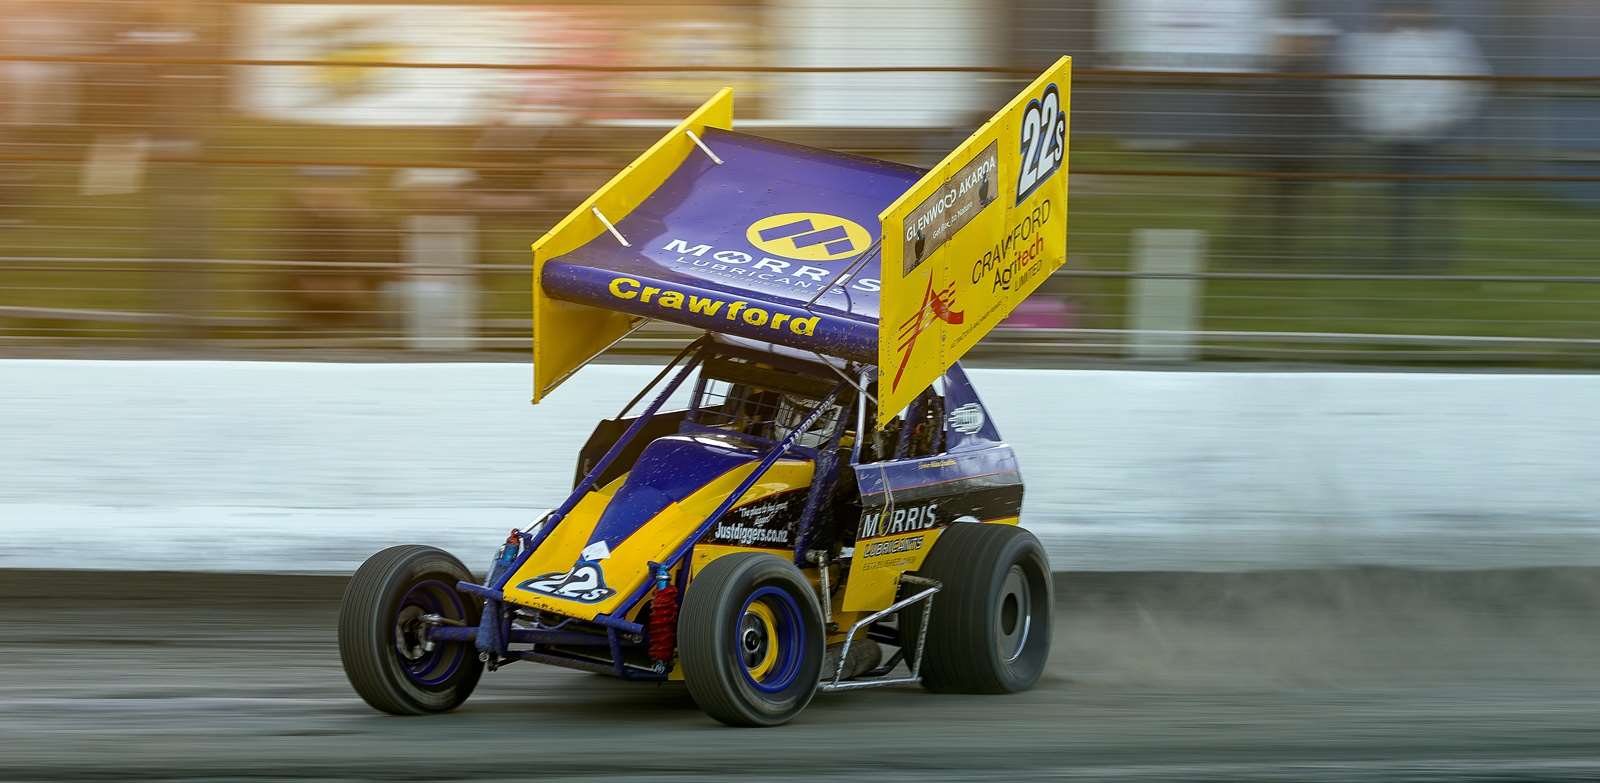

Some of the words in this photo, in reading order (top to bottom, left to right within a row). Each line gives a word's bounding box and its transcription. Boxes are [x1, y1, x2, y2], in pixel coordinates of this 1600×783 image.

[1018, 90, 1065, 196] 22s
[958, 155, 996, 198] AKAROA
[608, 277, 822, 337] Crawford
[714, 521, 788, 545] Justdiggers.co.nz
[528, 566, 609, 600] 22s
